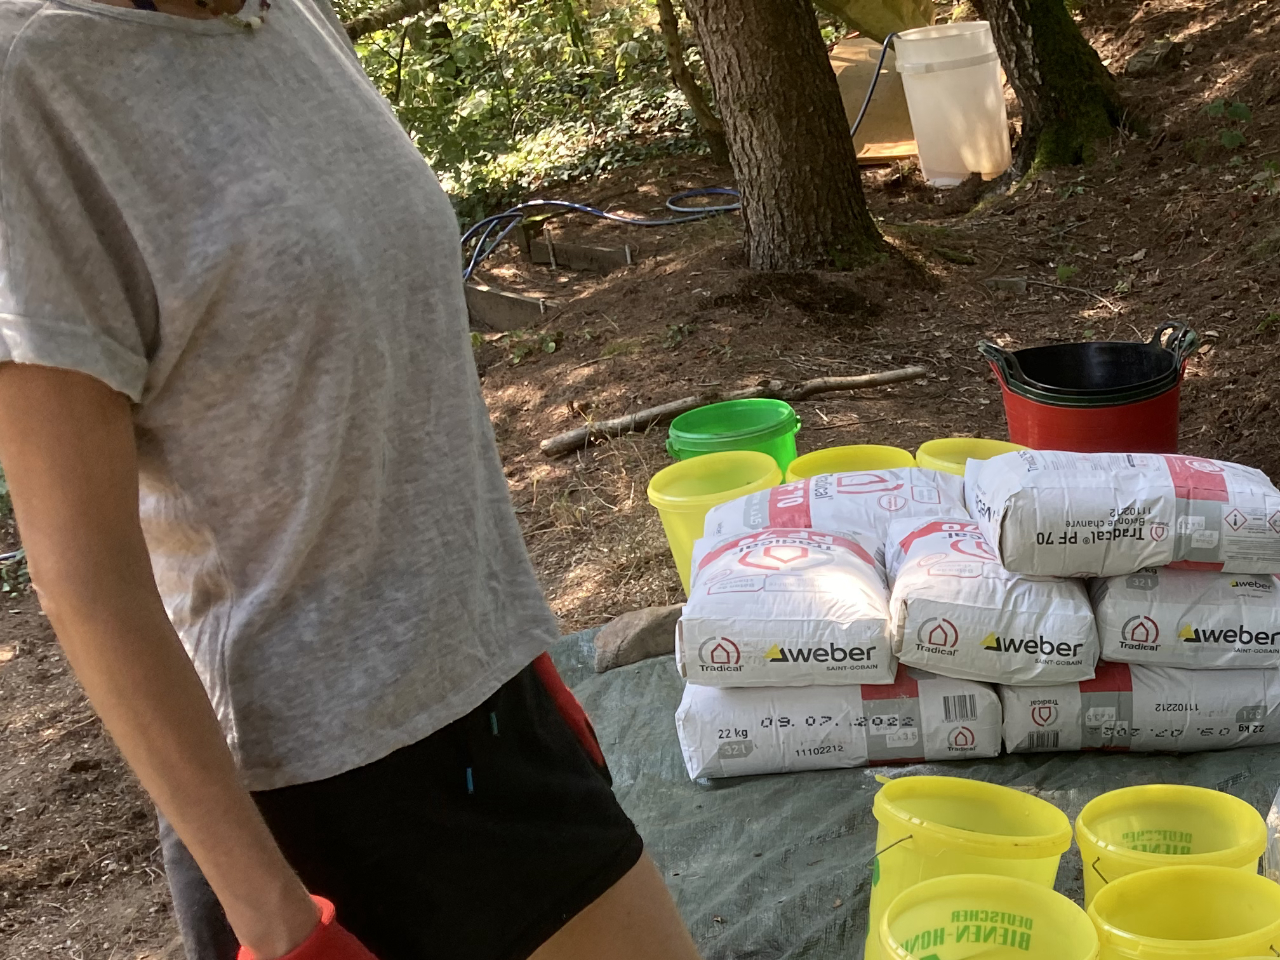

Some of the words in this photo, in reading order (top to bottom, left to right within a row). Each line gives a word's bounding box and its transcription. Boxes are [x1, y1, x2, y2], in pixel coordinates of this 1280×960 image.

[1036, 532, 1053, 545] 70
[1058, 531, 1077, 545] PF
[1238, 581, 1272, 590] weber
[1202, 625, 1280, 645] weber
[787, 642, 876, 663] weber
[915, 643, 957, 656] Tradical
[1003, 636, 1083, 657] weber
[699, 664, 742, 673] Tradical
[1155, 703, 1198, 712] 11102212
[718, 729, 733, 739] 22
[735, 727, 748, 740] kg
[1239, 724, 1250, 733] kg
[1252, 725, 1265, 733] 22
[795, 744, 844, 757] 11102212
